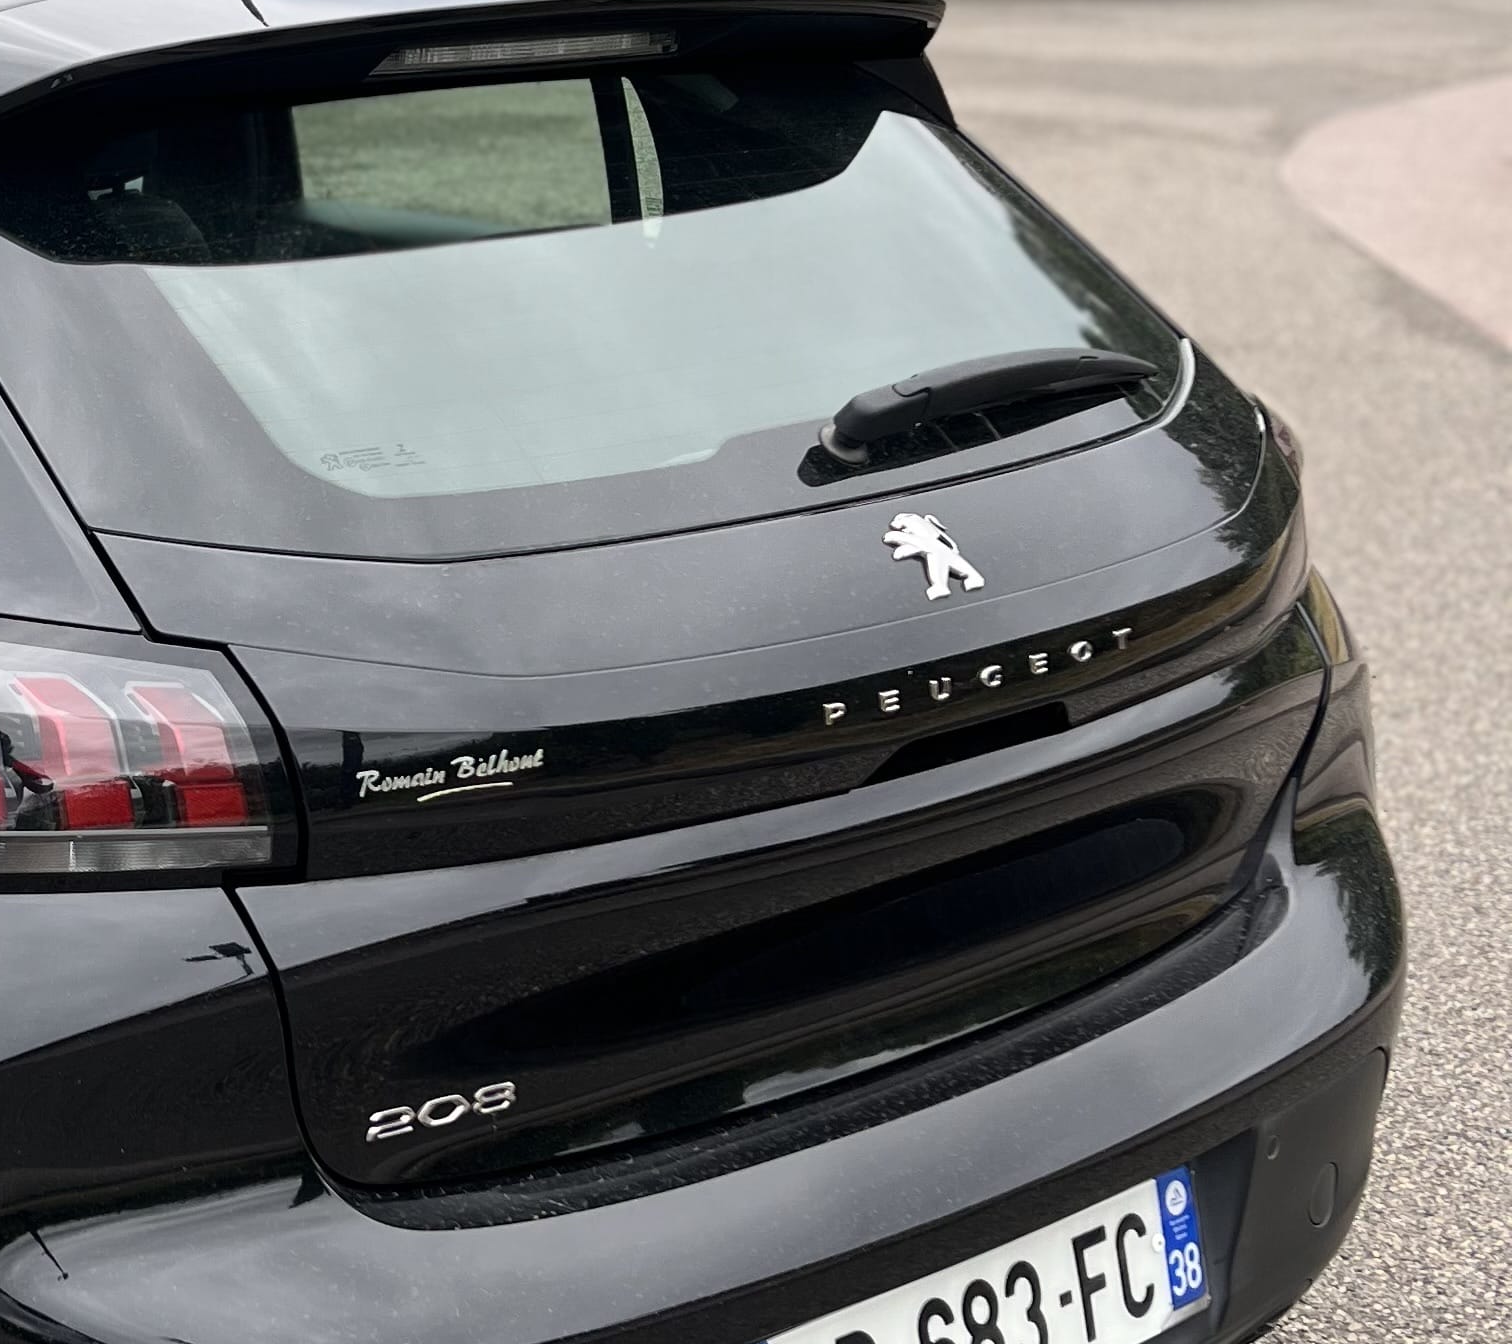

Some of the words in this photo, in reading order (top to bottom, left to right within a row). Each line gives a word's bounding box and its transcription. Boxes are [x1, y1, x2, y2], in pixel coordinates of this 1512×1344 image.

[822, 627, 1133, 726] PEUGEOT
[356, 767, 446, 798] Romain
[365, 1081, 517, 1142] 208
[1169, 1241, 1203, 1297] 38
